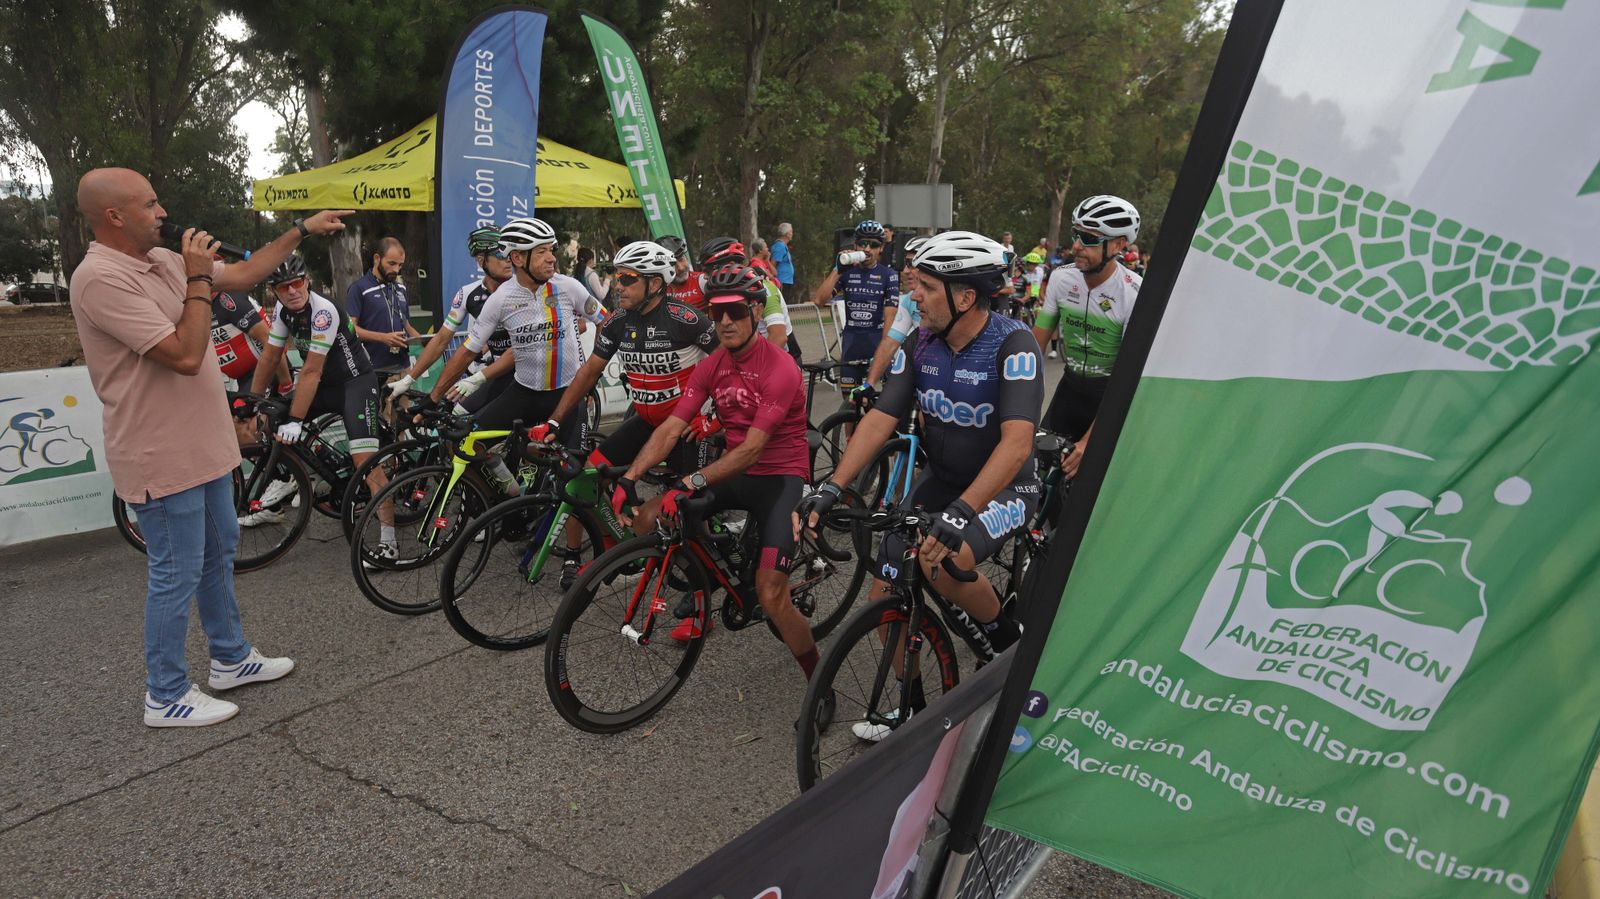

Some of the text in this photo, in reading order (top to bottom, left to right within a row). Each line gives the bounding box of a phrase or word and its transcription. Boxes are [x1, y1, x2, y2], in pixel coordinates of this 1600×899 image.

[474, 49, 494, 147] DEPORTES
[277, 189, 309, 199] XLMOTO
[368, 187, 411, 199] XLMOTO
[515, 329, 566, 344] ABOGADOS
[516, 319, 562, 333] DEL PINO
[620, 351, 681, 364] NDALUCIA
[631, 388, 681, 404] OUDAL
[978, 498, 1026, 539] wiber
[1225, 624, 1371, 678] ANDALUZA
[1256, 658, 1431, 722] DE CICLISMO
[1100, 658, 1511, 819] andaluciaciclismo.com
[1037, 734, 1193, 812] @FACiclismo
[1053, 705, 1530, 895] Federación Andaluza de Ciclismo
